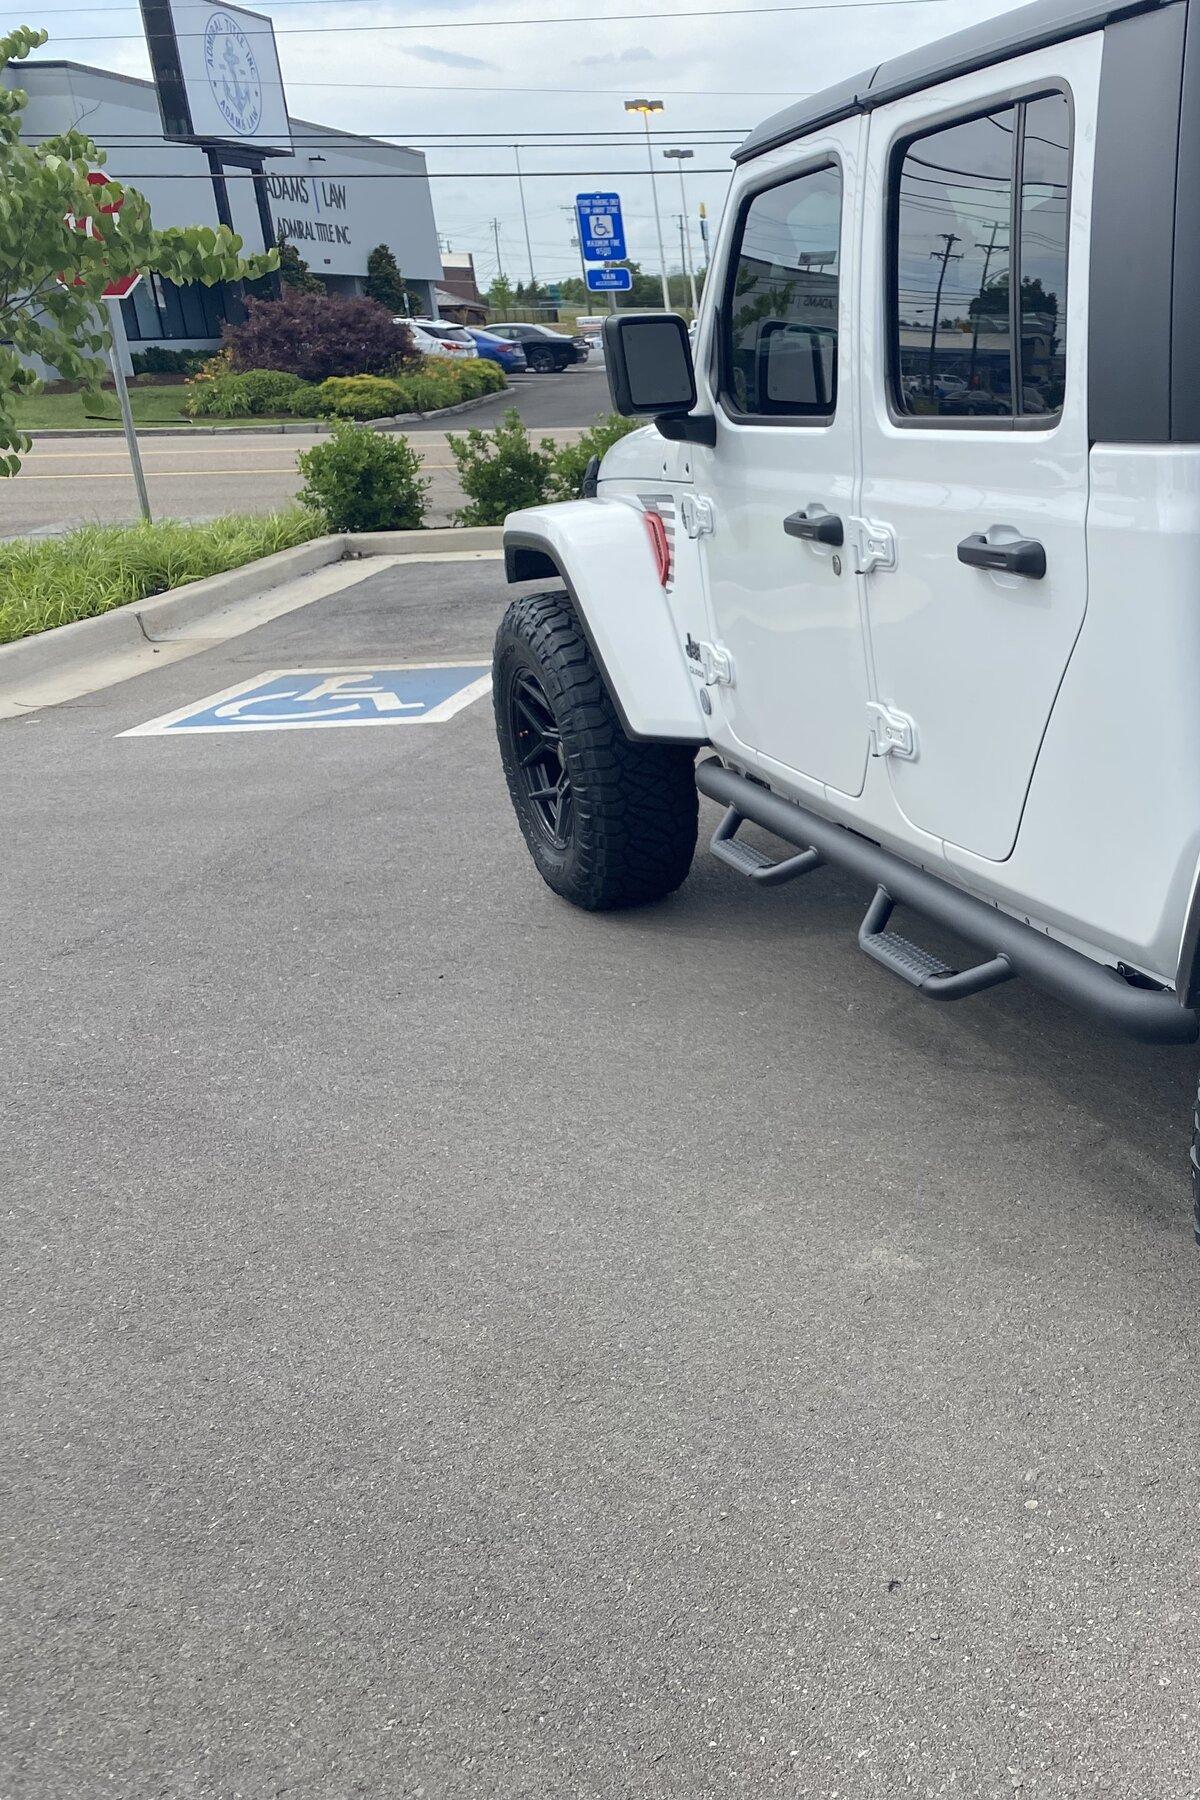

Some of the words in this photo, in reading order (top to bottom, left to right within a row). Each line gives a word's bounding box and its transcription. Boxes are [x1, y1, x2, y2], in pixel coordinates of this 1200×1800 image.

[220, 99, 246, 130] ADAMS
[265, 171, 309, 204] ADAMS
[321, 181, 346, 210] LAW
[277, 217, 316, 241] ADMIRAL
[315, 222, 335, 243] TITLE
[335, 224, 351, 245] INC
